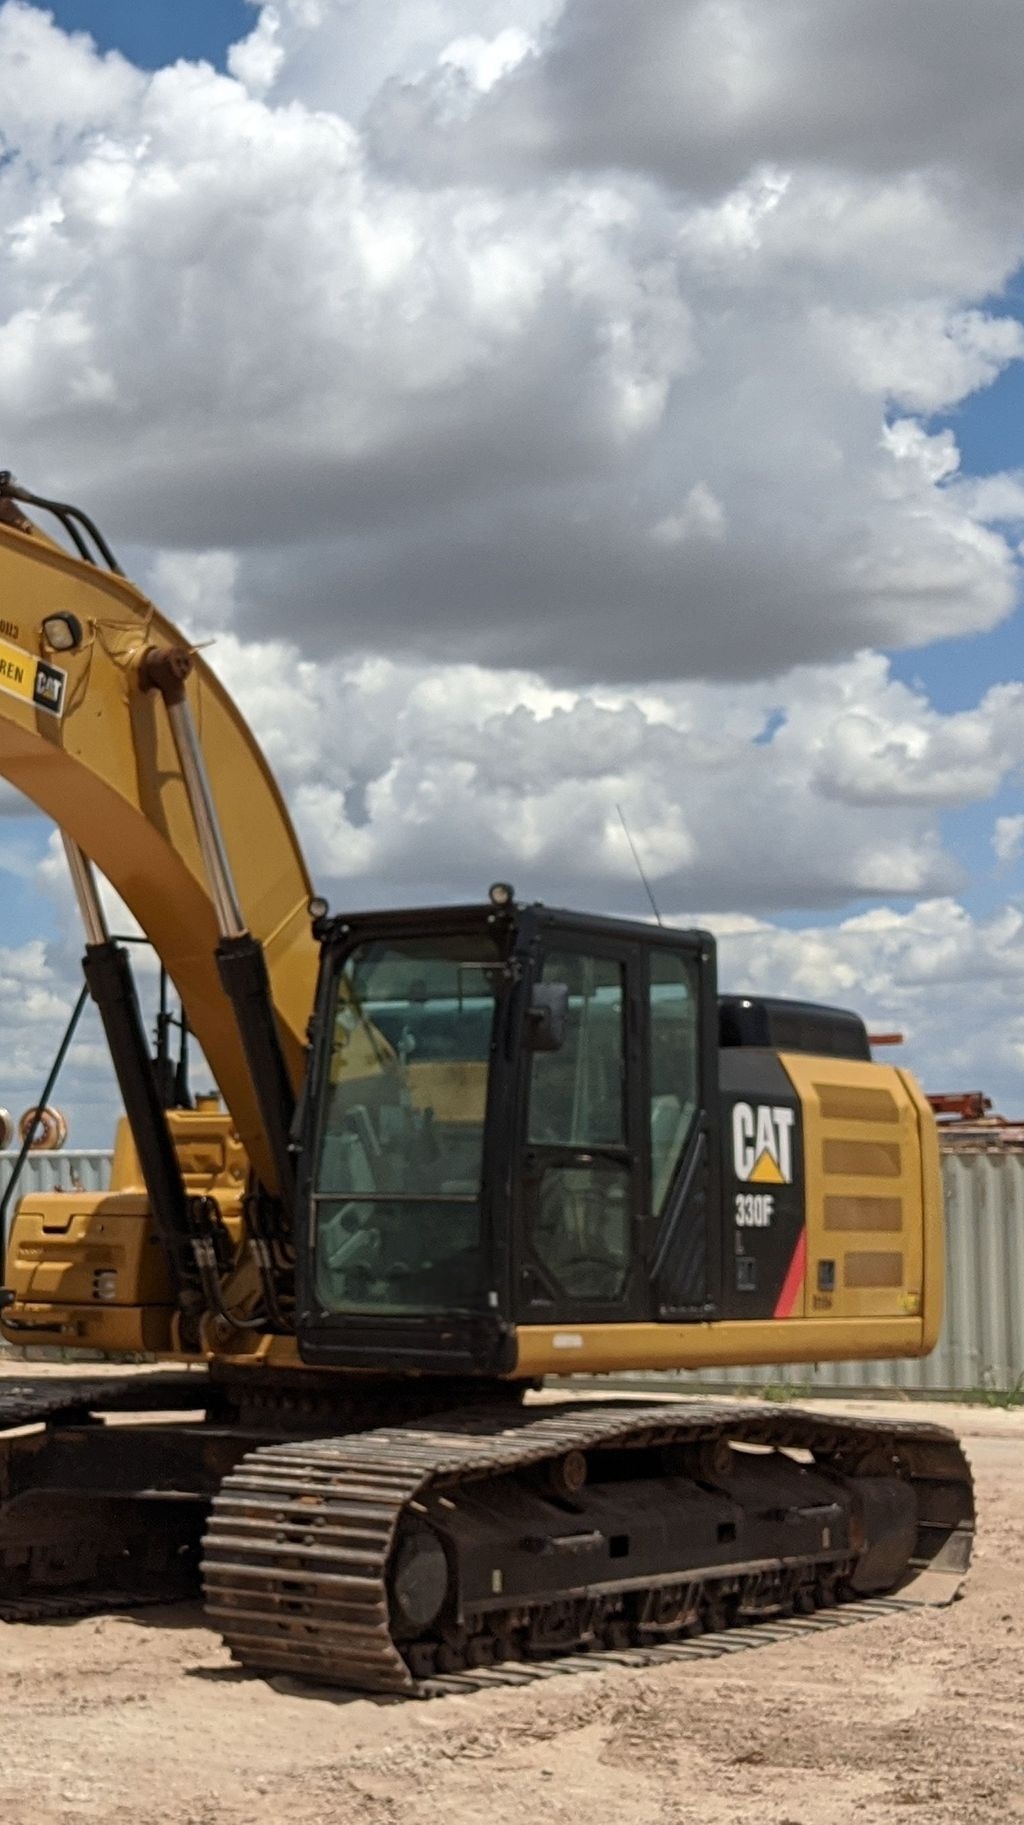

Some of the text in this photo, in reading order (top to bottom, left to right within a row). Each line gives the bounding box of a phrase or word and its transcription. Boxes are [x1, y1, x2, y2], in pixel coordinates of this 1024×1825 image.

[36, 671, 62, 702] CAT
[733, 1102, 794, 1184] CAT
[735, 1194, 774, 1227] 330F
